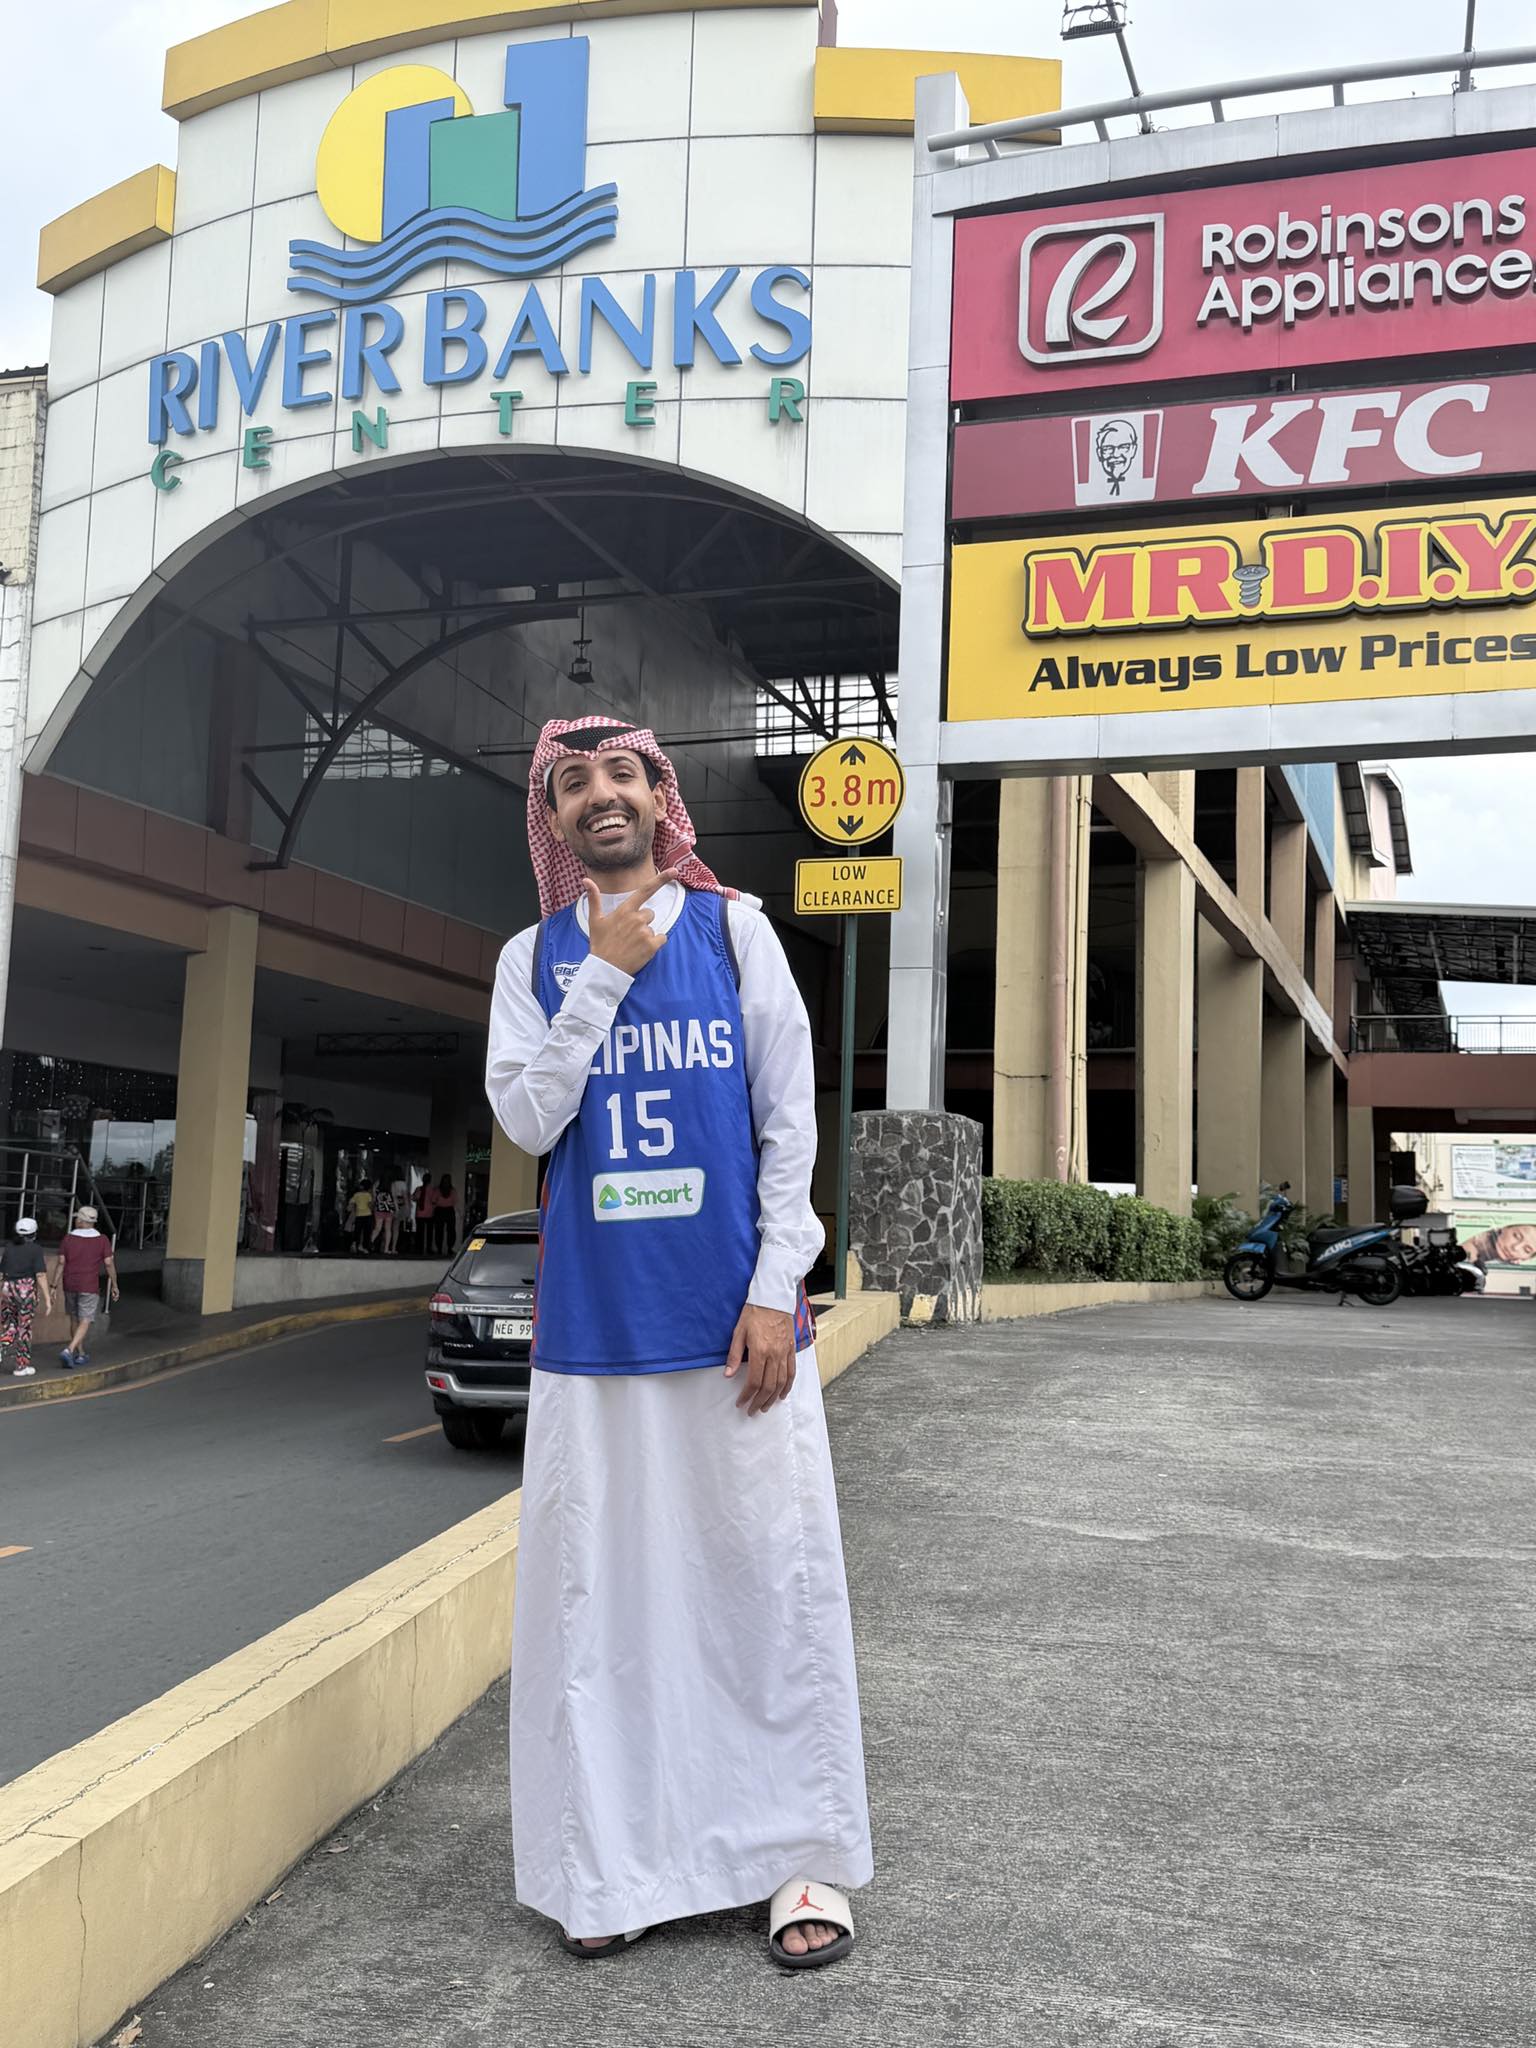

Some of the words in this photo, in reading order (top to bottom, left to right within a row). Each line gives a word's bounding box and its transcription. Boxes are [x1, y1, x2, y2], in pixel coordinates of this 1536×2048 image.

[1202, 194, 1527, 270] Robinsons
[1195, 248, 1536, 328] Appliance
[148, 265, 812, 445] RIVERBANKS
[150, 377, 805, 491] CENTER
[1192, 384, 1490, 494] KFC
[1028, 653, 1223, 692] Always
[1235, 643, 1348, 679] Low
[1359, 631, 1536, 671] Prices
[810, 774, 897, 808] 3.8m
[803, 889, 895, 907] CLEARANCE
[832, 865, 867, 881] LOW
[606, 1089, 675, 1160] 15
[623, 1182, 693, 1207] Smart
[495, 1323, 513, 1335] NEG
